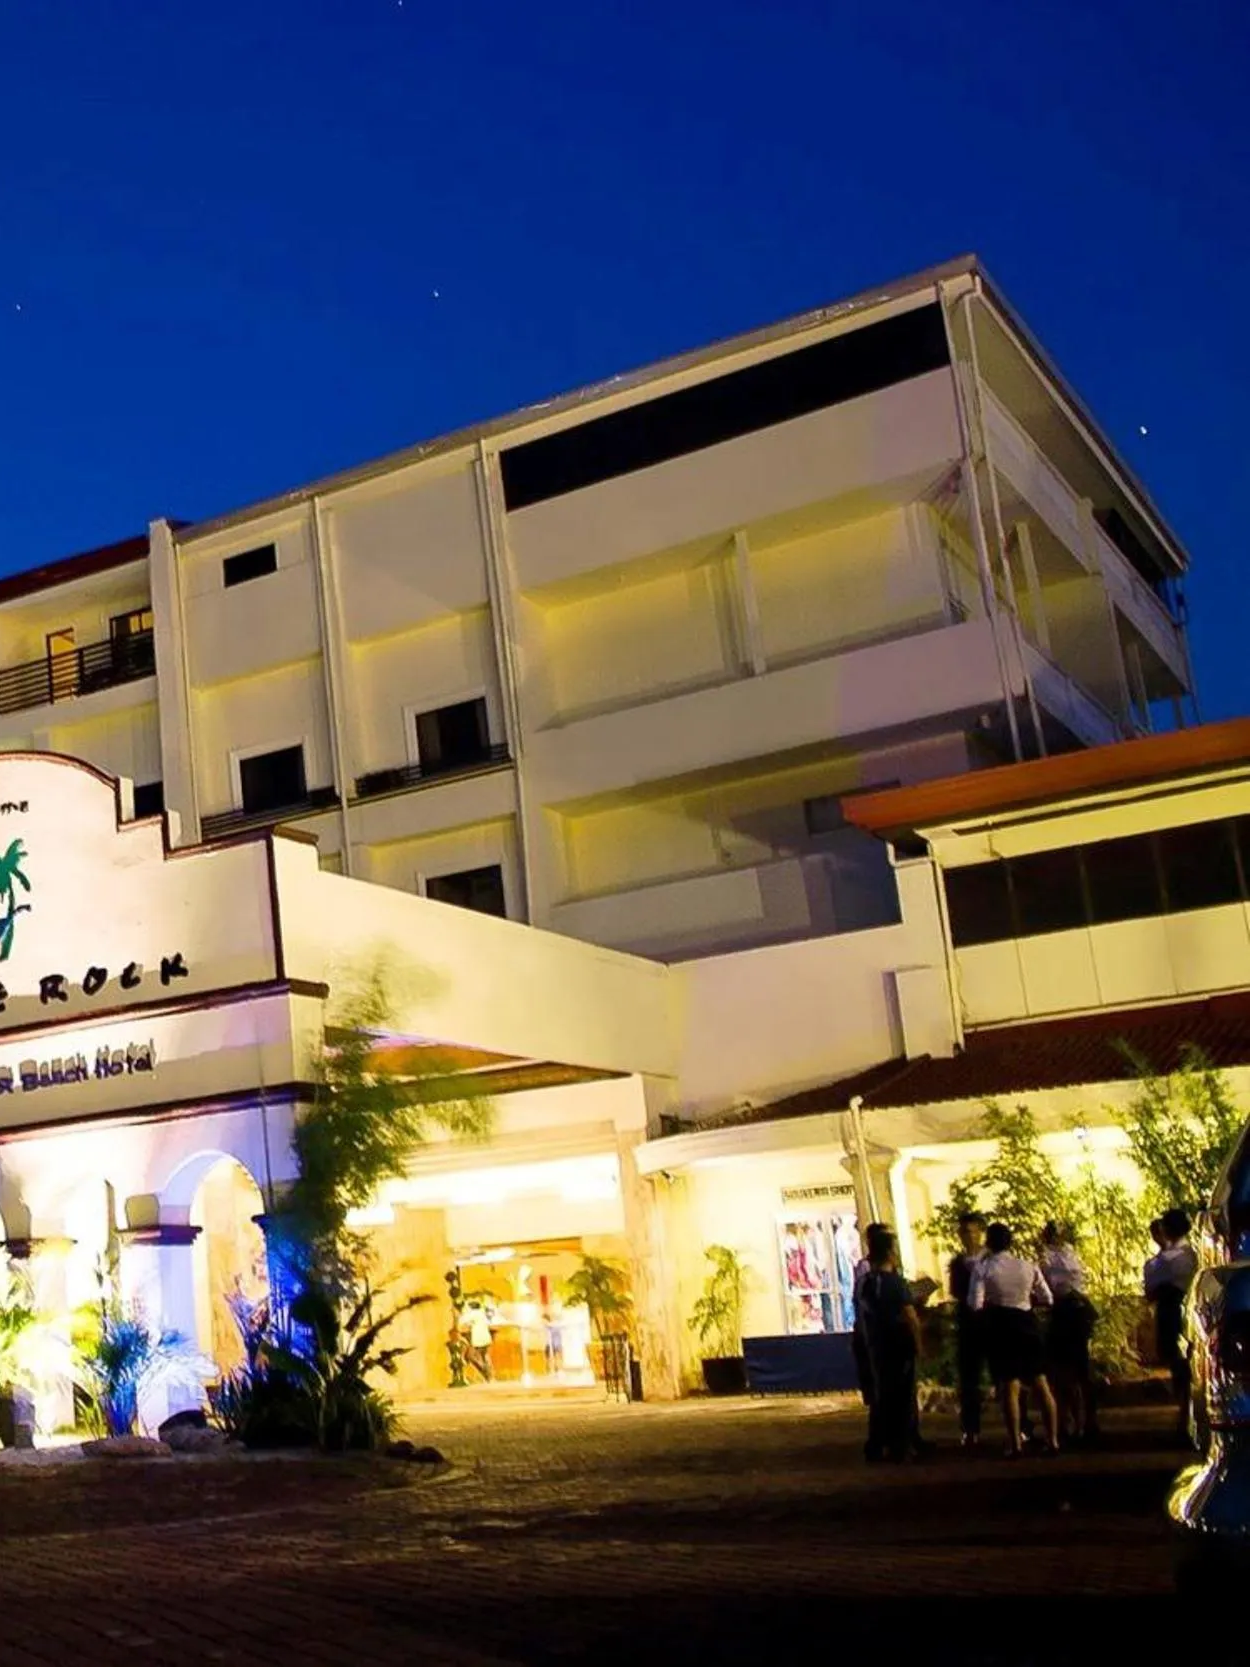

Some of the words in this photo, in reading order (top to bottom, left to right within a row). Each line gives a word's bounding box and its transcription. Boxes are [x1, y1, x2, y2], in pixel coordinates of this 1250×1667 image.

[39, 952, 190, 1005] ROCK
[20, 1060, 89, 1092] Beach
[94, 1047, 154, 1079] Hotel
